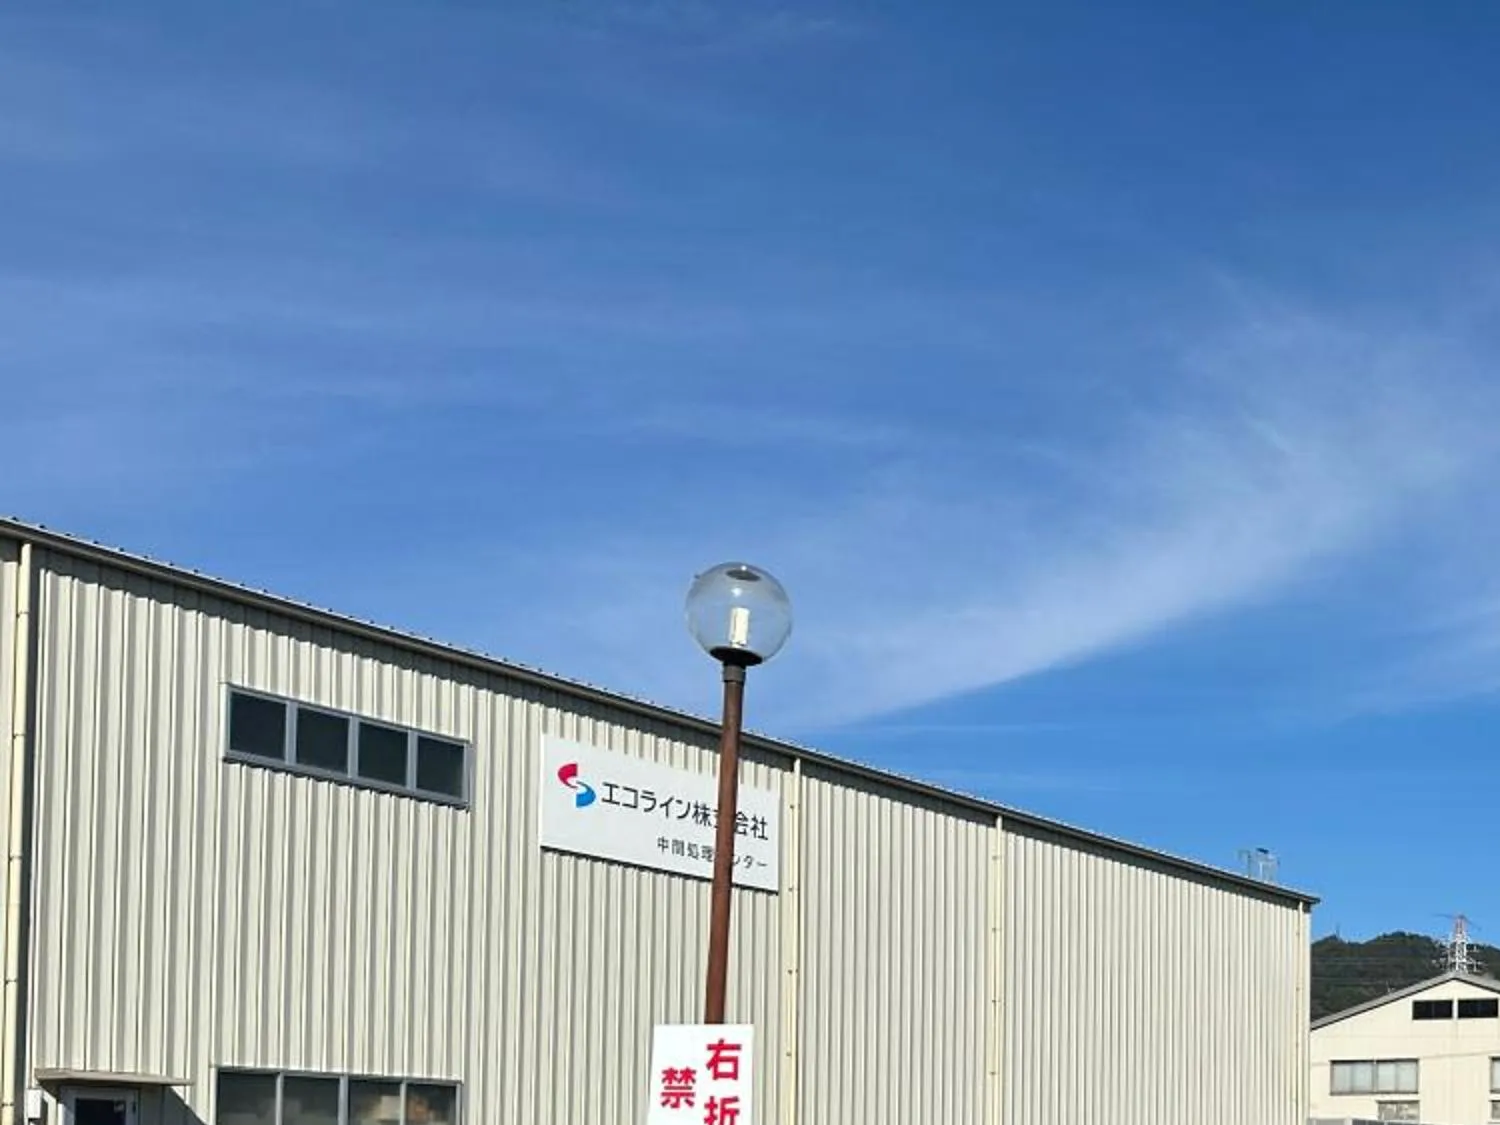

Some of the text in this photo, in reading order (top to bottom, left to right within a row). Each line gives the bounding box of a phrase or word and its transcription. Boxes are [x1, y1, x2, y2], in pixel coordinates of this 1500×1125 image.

[601, 781, 769, 841] エコライン株会社
[657, 836, 768, 869] 中間処理ンター
